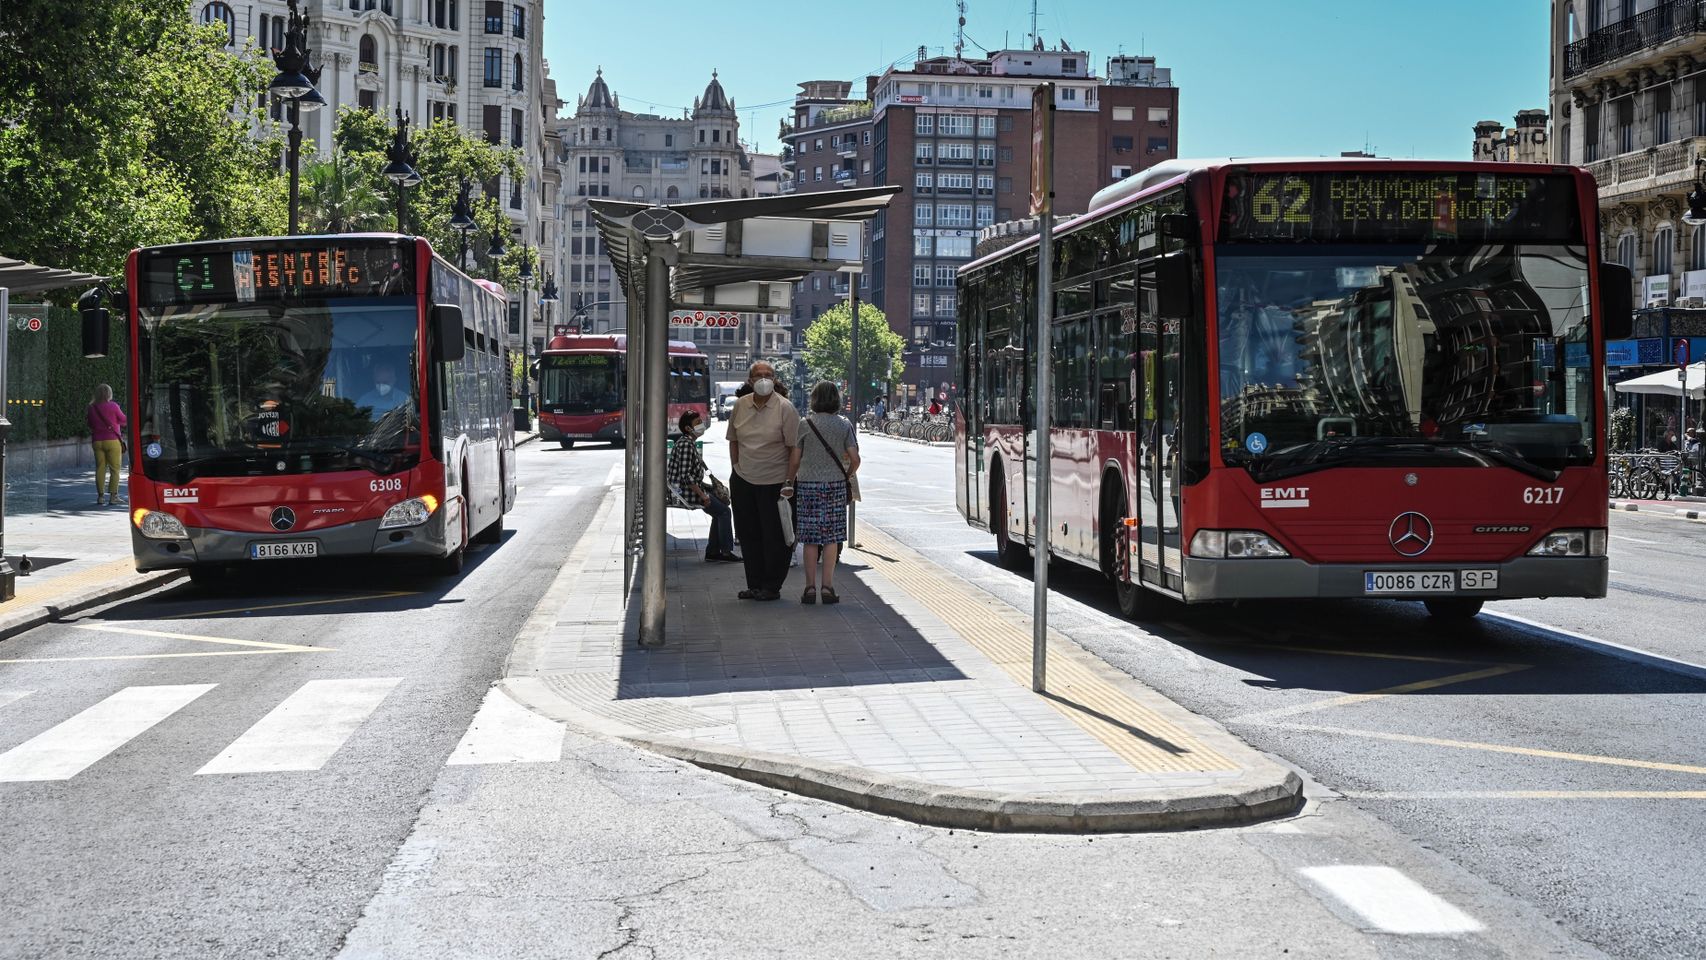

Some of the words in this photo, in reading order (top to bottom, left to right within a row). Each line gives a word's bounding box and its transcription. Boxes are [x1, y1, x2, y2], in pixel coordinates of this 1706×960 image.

[1252, 179, 1313, 223] 62
[1342, 200, 1394, 220] EST.
[1401, 200, 1442, 220] DEL
[1449, 200, 1512, 220] NORD
[177, 257, 214, 291] C1
[251, 249, 346, 273] CENTRE
[238, 265, 360, 289] HISTORIC
[163, 487, 199, 497] EMT
[369, 478, 402, 492] 6308
[1260, 487, 1310, 499] EMT
[1523, 487, 1564, 504] 6217
[258, 544, 289, 557] 8166
[292, 543, 315, 555] KXB
[1375, 575, 1415, 590] 0086
[1421, 574, 1451, 590] CZR
[1464, 572, 1494, 587] SP
